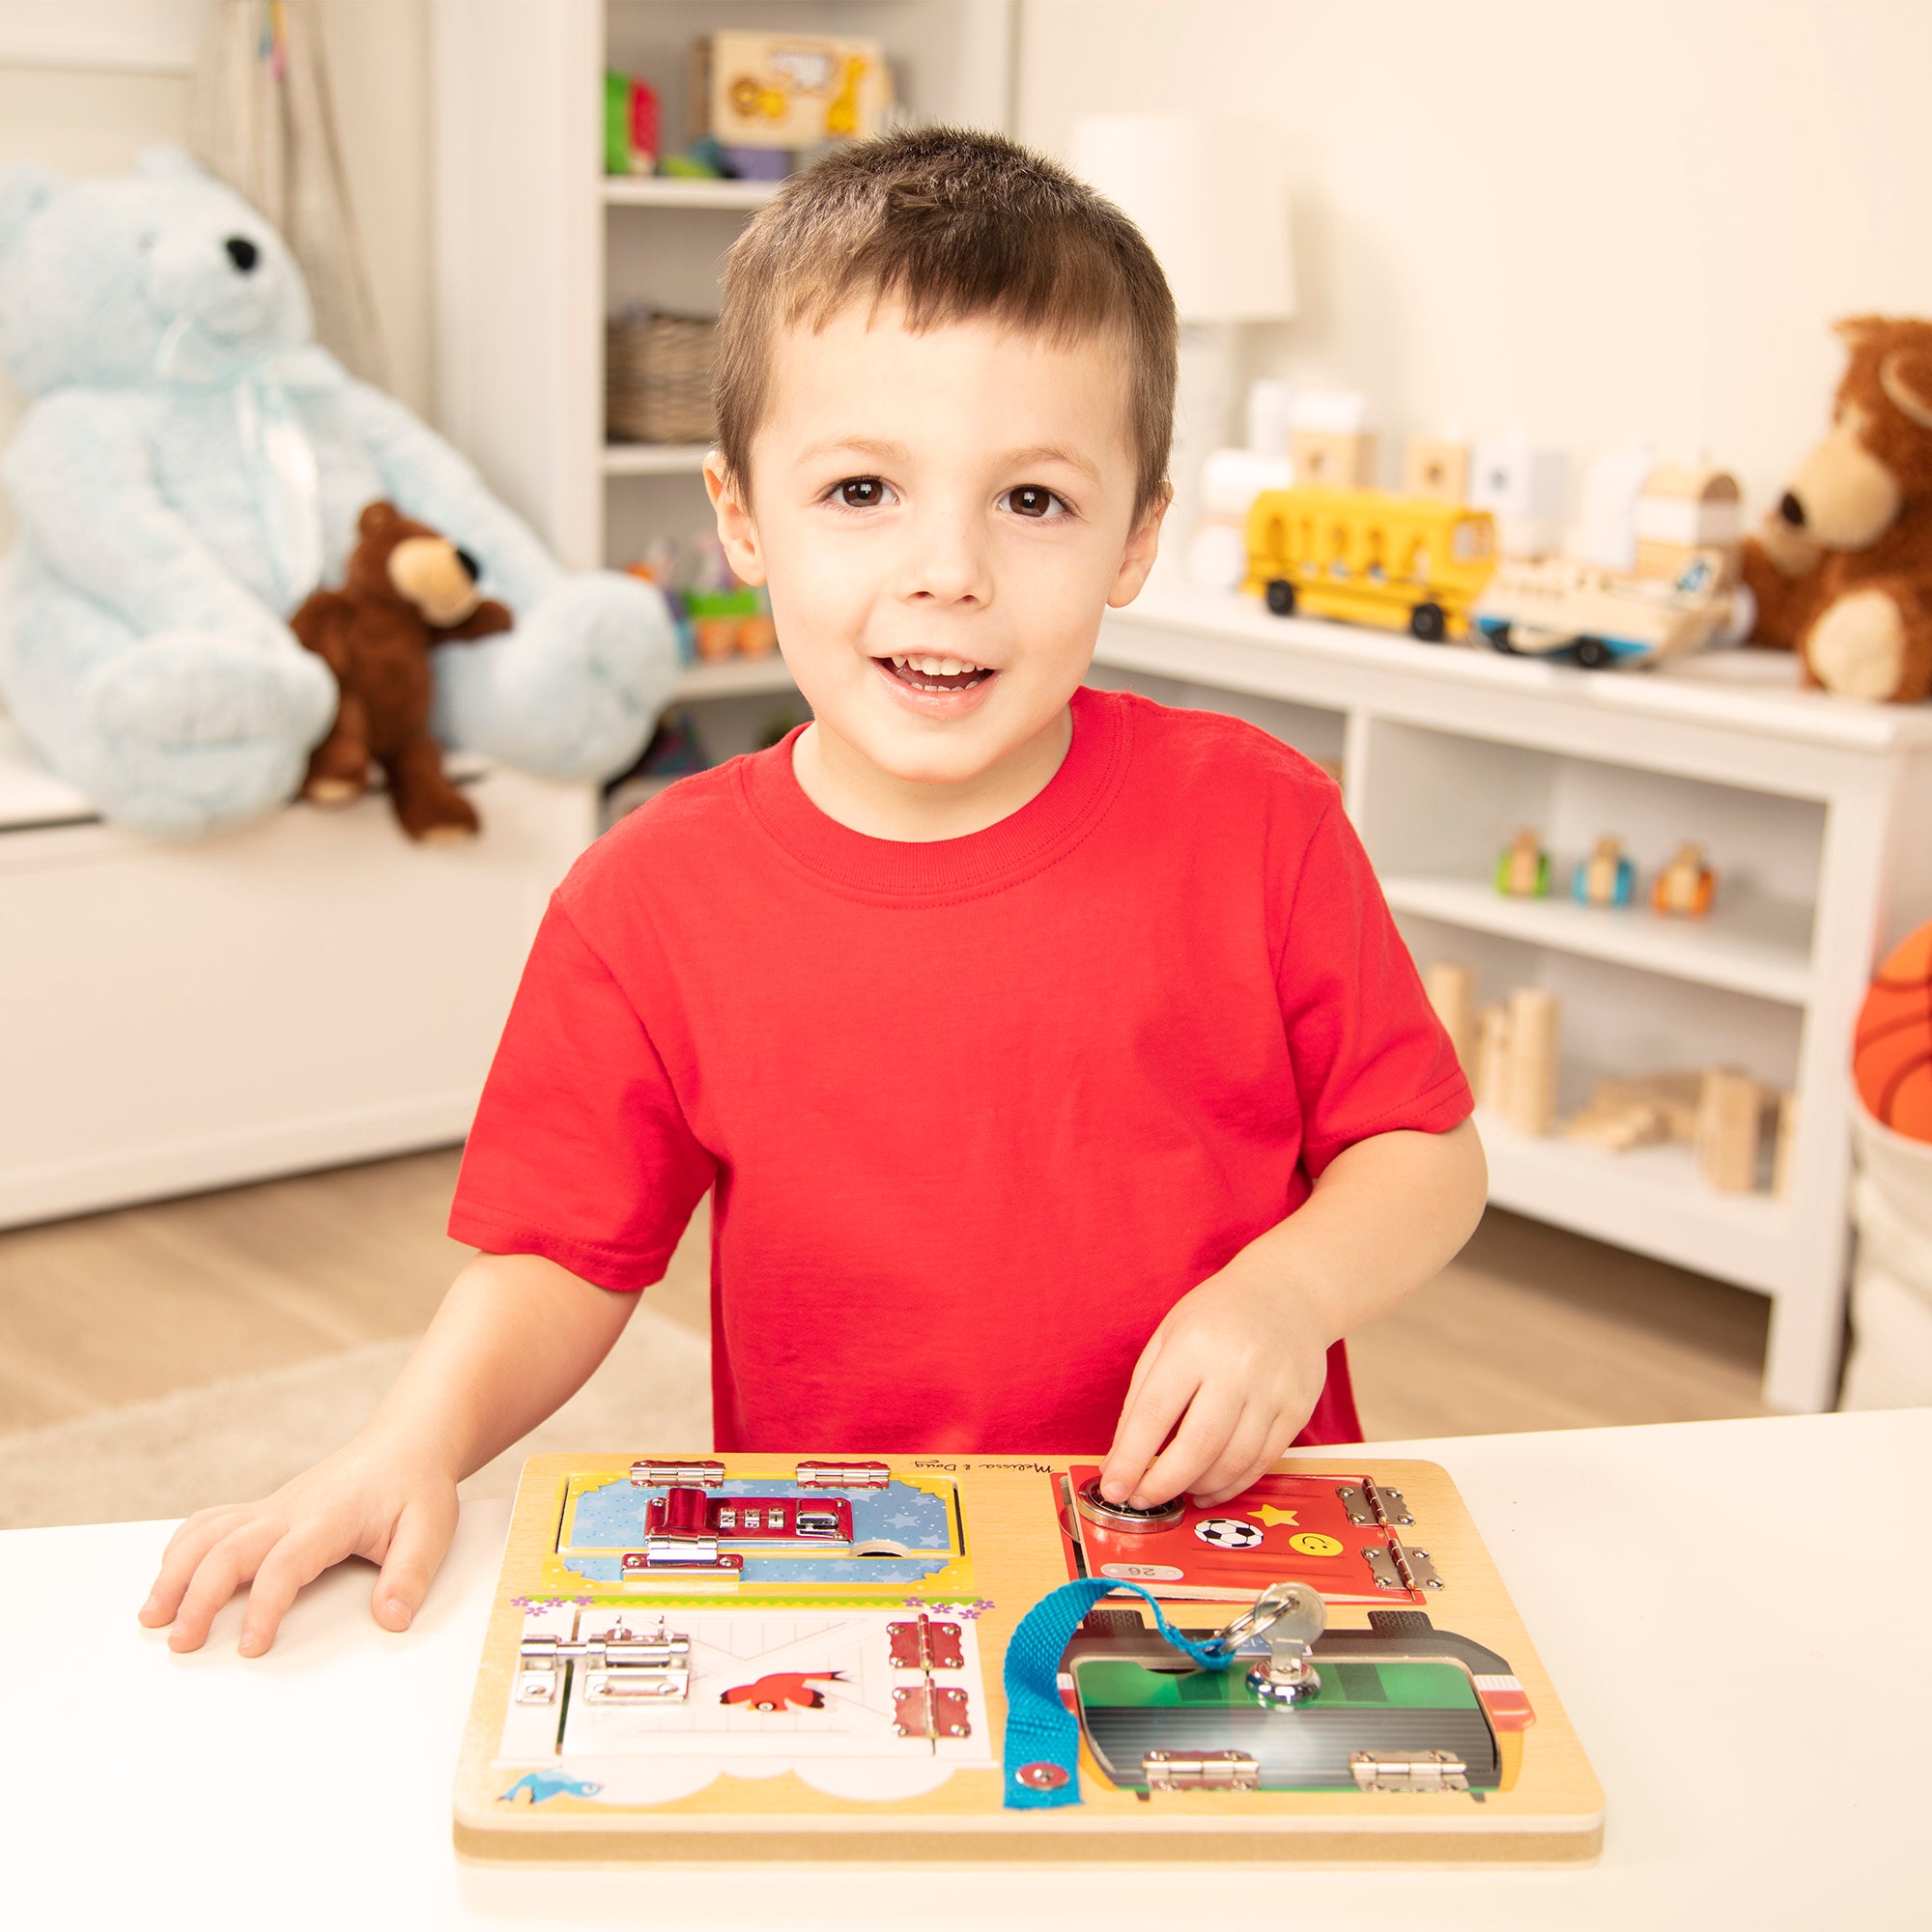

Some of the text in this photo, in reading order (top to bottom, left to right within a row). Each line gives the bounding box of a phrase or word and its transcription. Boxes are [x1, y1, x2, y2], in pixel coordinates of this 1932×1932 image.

[914, 1459, 956, 1471] Doug
[979, 1463, 1055, 1473] Melissa
[1127, 1567, 1155, 1577] 26
